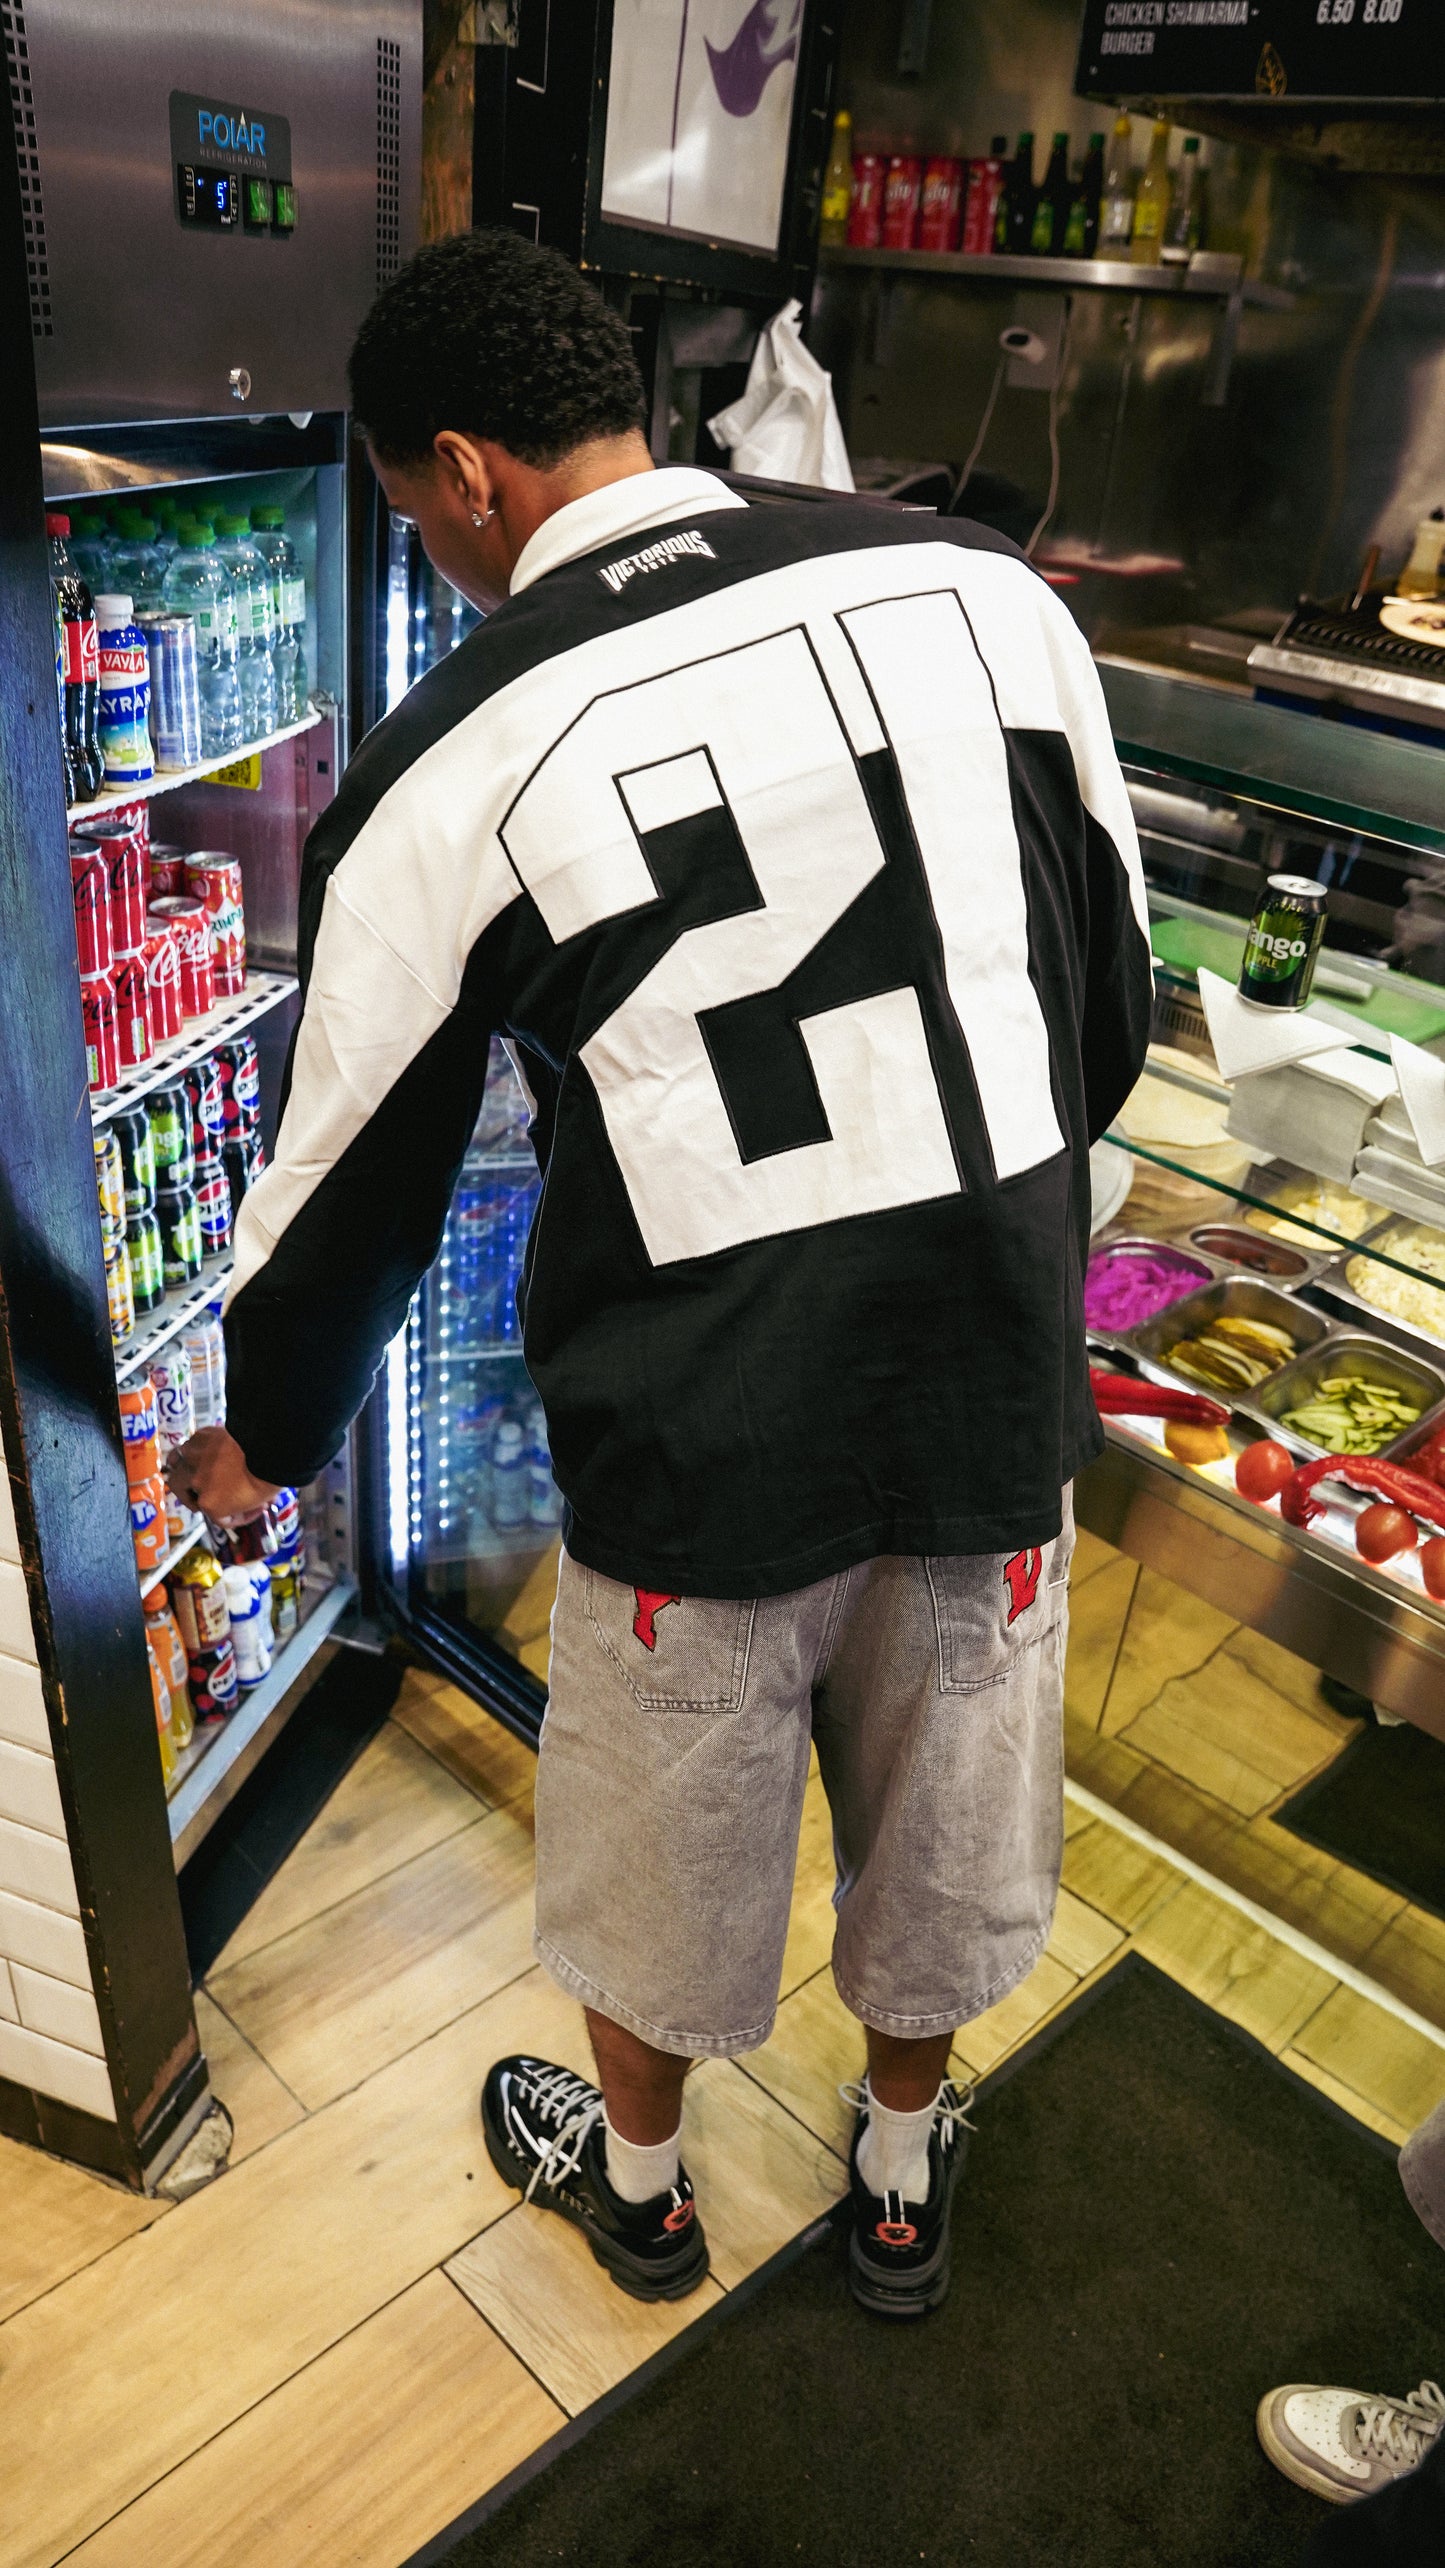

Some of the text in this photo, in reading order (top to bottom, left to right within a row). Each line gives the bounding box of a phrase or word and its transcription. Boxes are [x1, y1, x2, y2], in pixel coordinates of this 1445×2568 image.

[1104, 2, 1164, 26] CHICKEN
[1165, 1, 1248, 26] SHAWARMA
[1316, 0, 1354, 24] 6.50
[1362, 0, 1401, 24] 8.00
[1100, 31, 1155, 55] BURGER
[198, 110, 266, 157] POLAR
[599, 529, 718, 592] VICTORIOUS
[103, 650, 145, 672] YAYLA
[498, 588, 1070, 1268] 21
